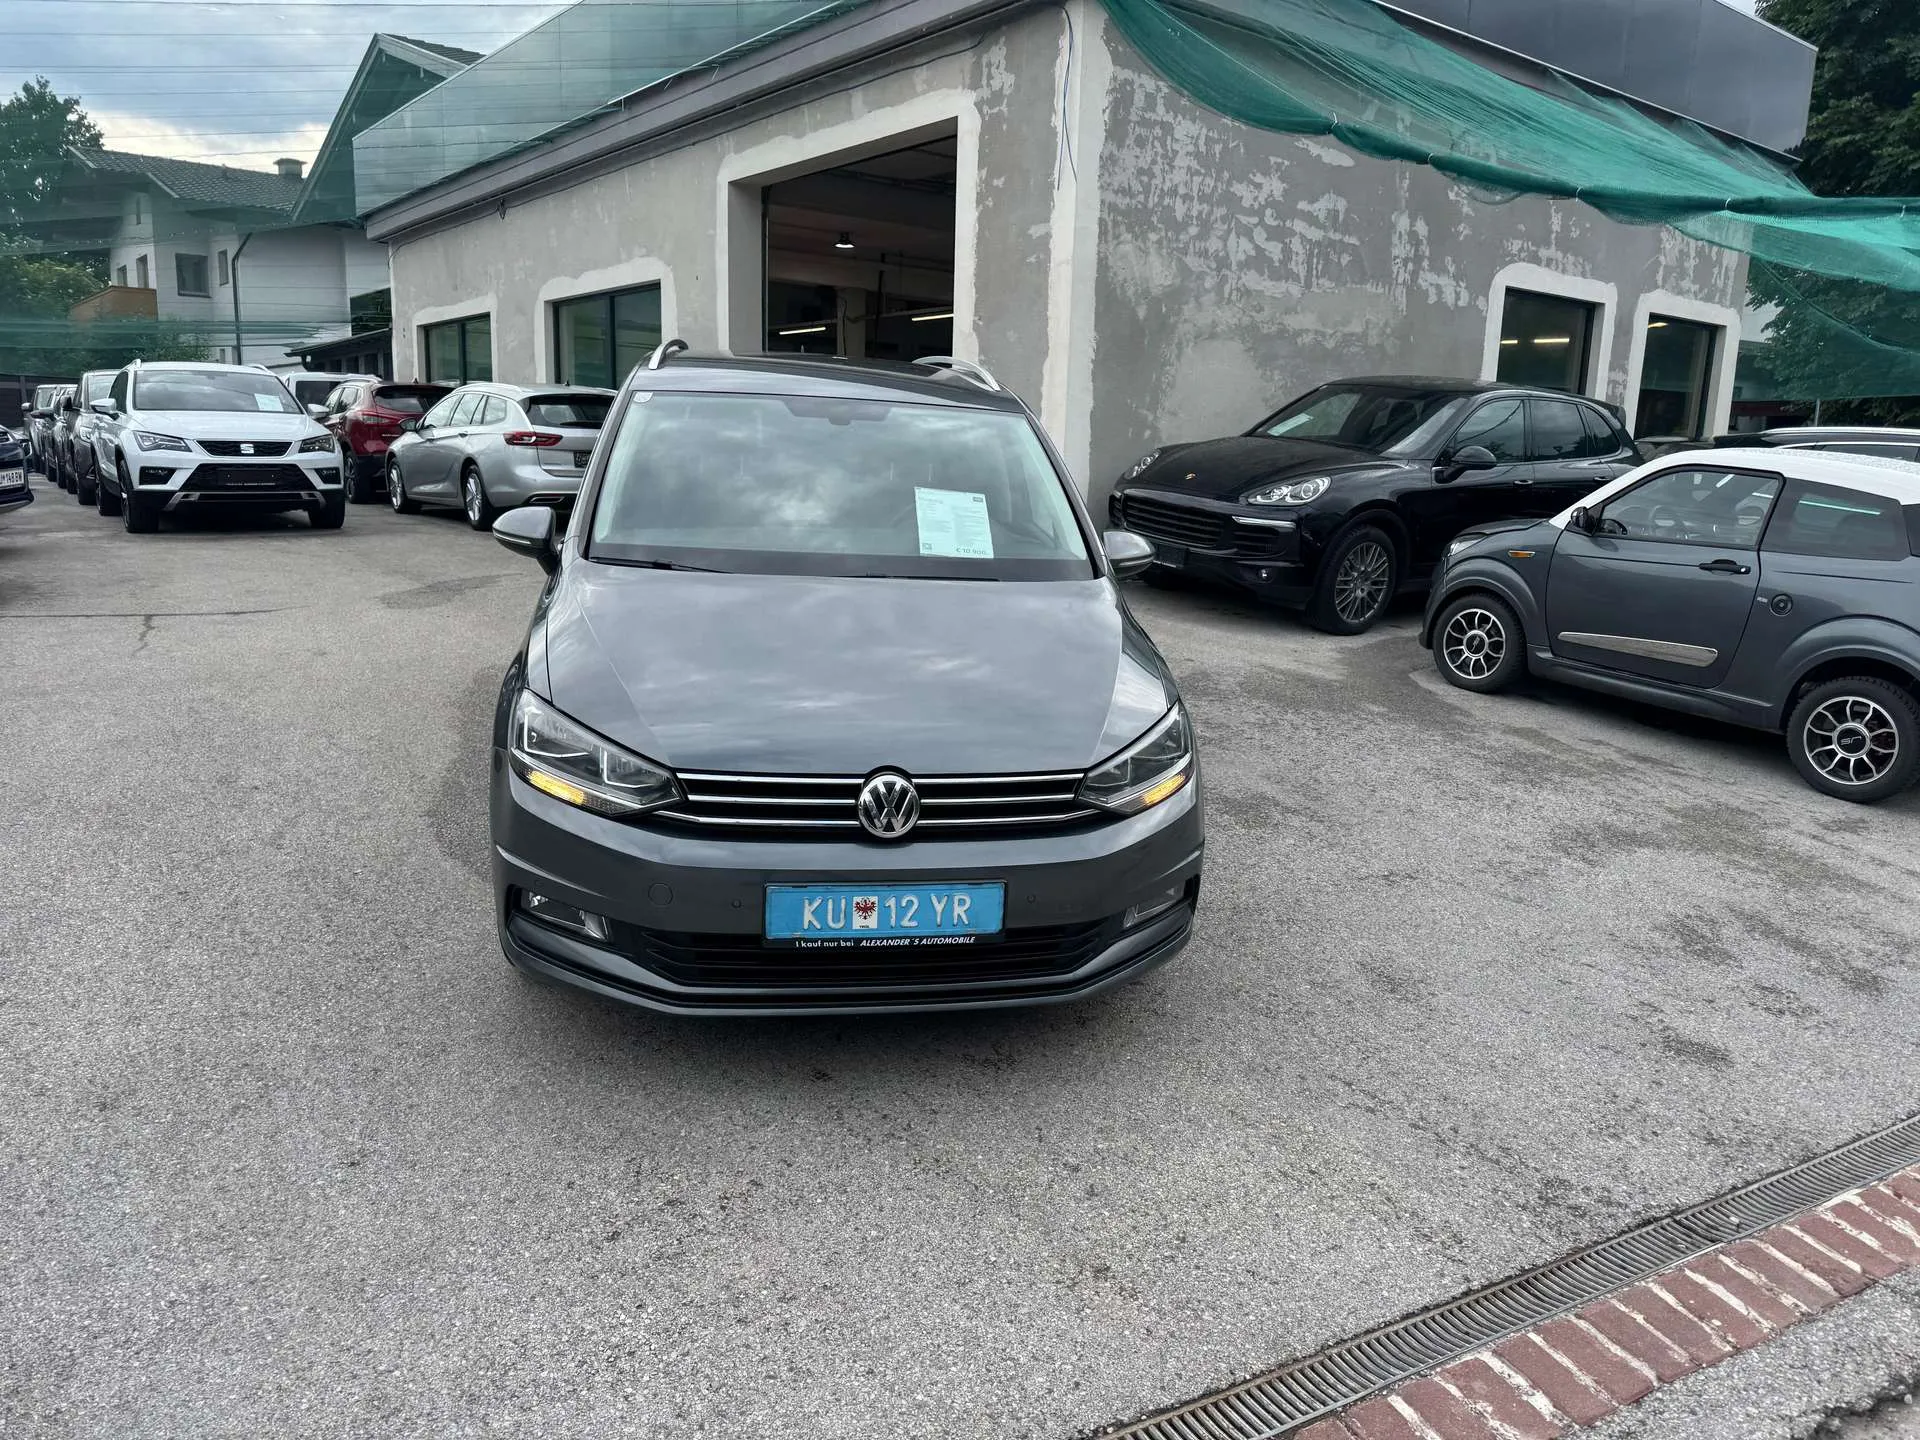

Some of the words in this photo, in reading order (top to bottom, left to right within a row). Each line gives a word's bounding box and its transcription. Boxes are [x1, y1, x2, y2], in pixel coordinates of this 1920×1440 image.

[802, 895, 847, 930] KU
[884, 894, 920, 929] 12
[929, 893, 973, 928] YR
[800, 940, 822, 948] kauf
[920, 936, 976, 946] AUTOMOBILE
